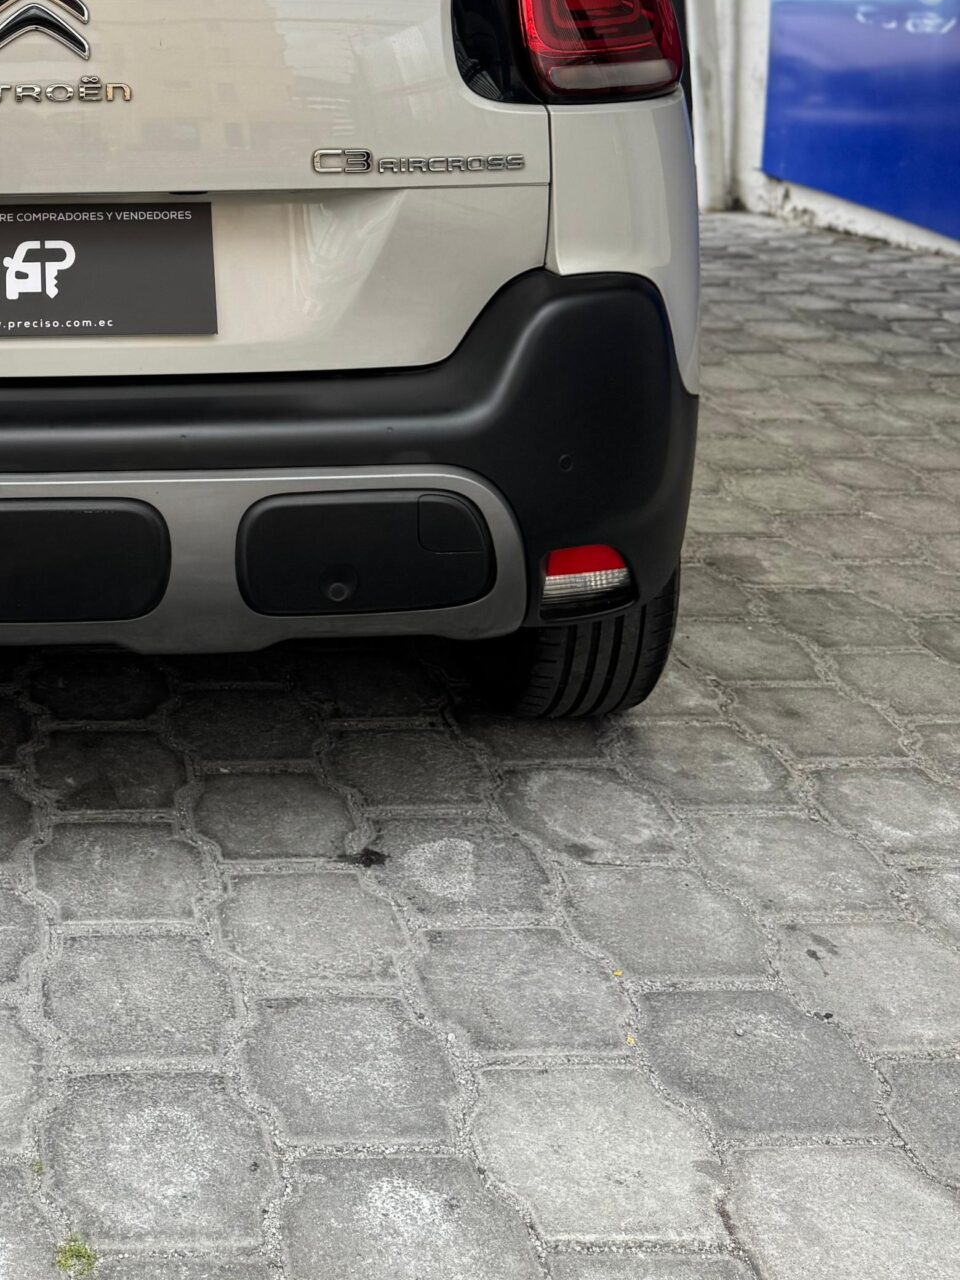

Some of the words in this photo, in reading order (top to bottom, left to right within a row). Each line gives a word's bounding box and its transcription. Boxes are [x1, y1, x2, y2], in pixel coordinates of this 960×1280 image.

[313, 148, 373, 174] C3
[377, 153, 526, 175] AIRCROSS
[16, 211, 104, 222] COMPRADORES
[106, 211, 113, 221] Y
[115, 210, 193, 221] VENDEDORES
